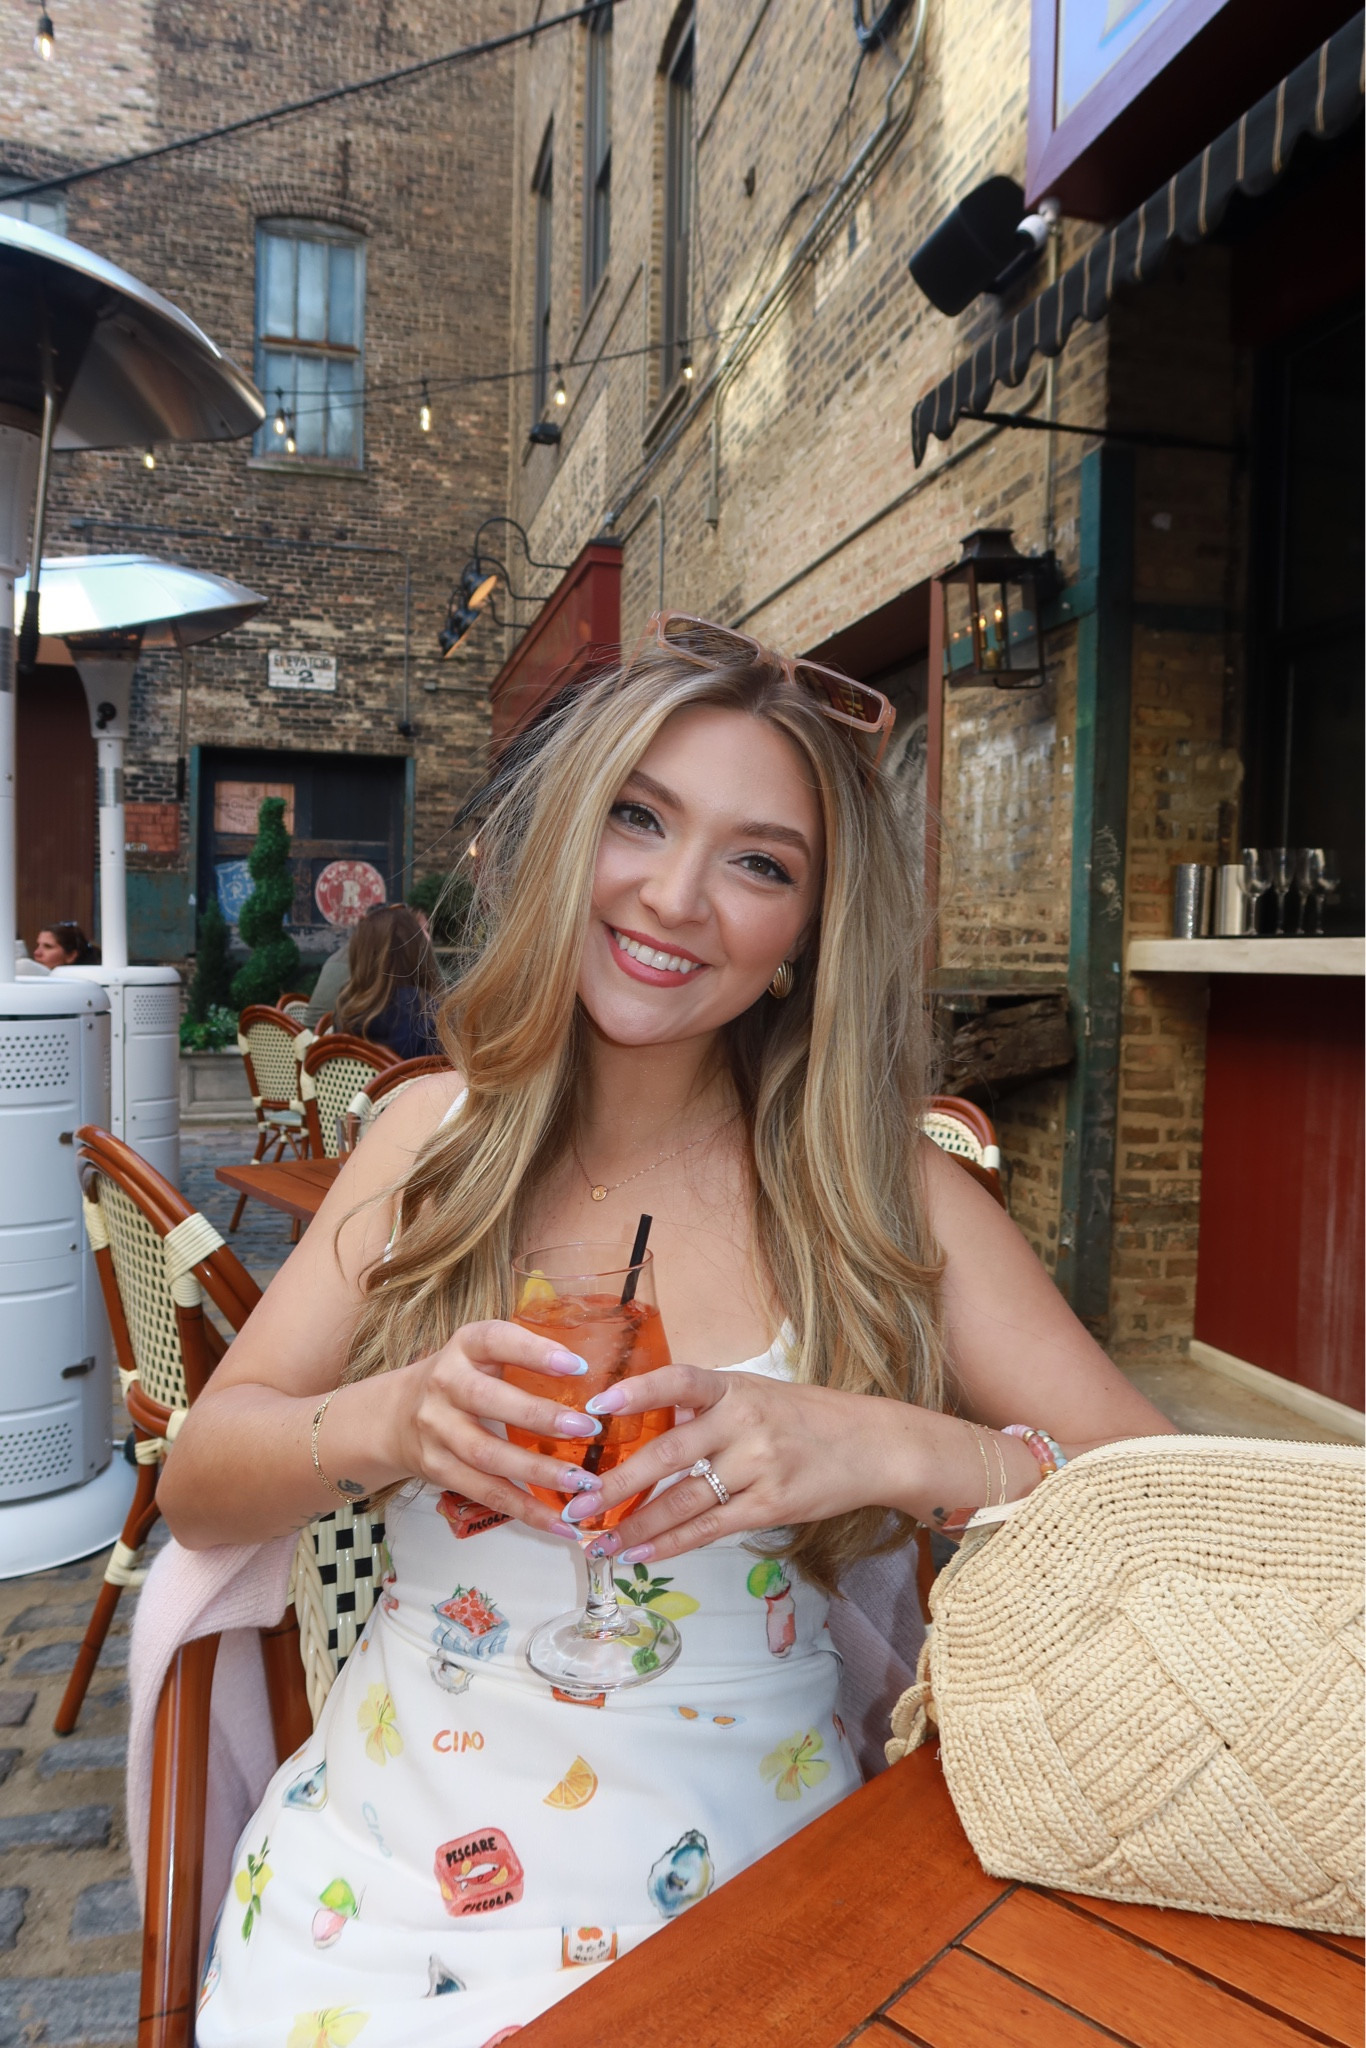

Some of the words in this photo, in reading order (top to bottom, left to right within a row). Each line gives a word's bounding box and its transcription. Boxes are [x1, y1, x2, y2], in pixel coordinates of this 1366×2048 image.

[274, 655, 331, 670] ELEVATOR
[299, 669, 315, 683] 2
[341, 881, 361, 909] R
[432, 1729, 485, 1753] CIAO
[445, 1836, 498, 1868] PESCARE
